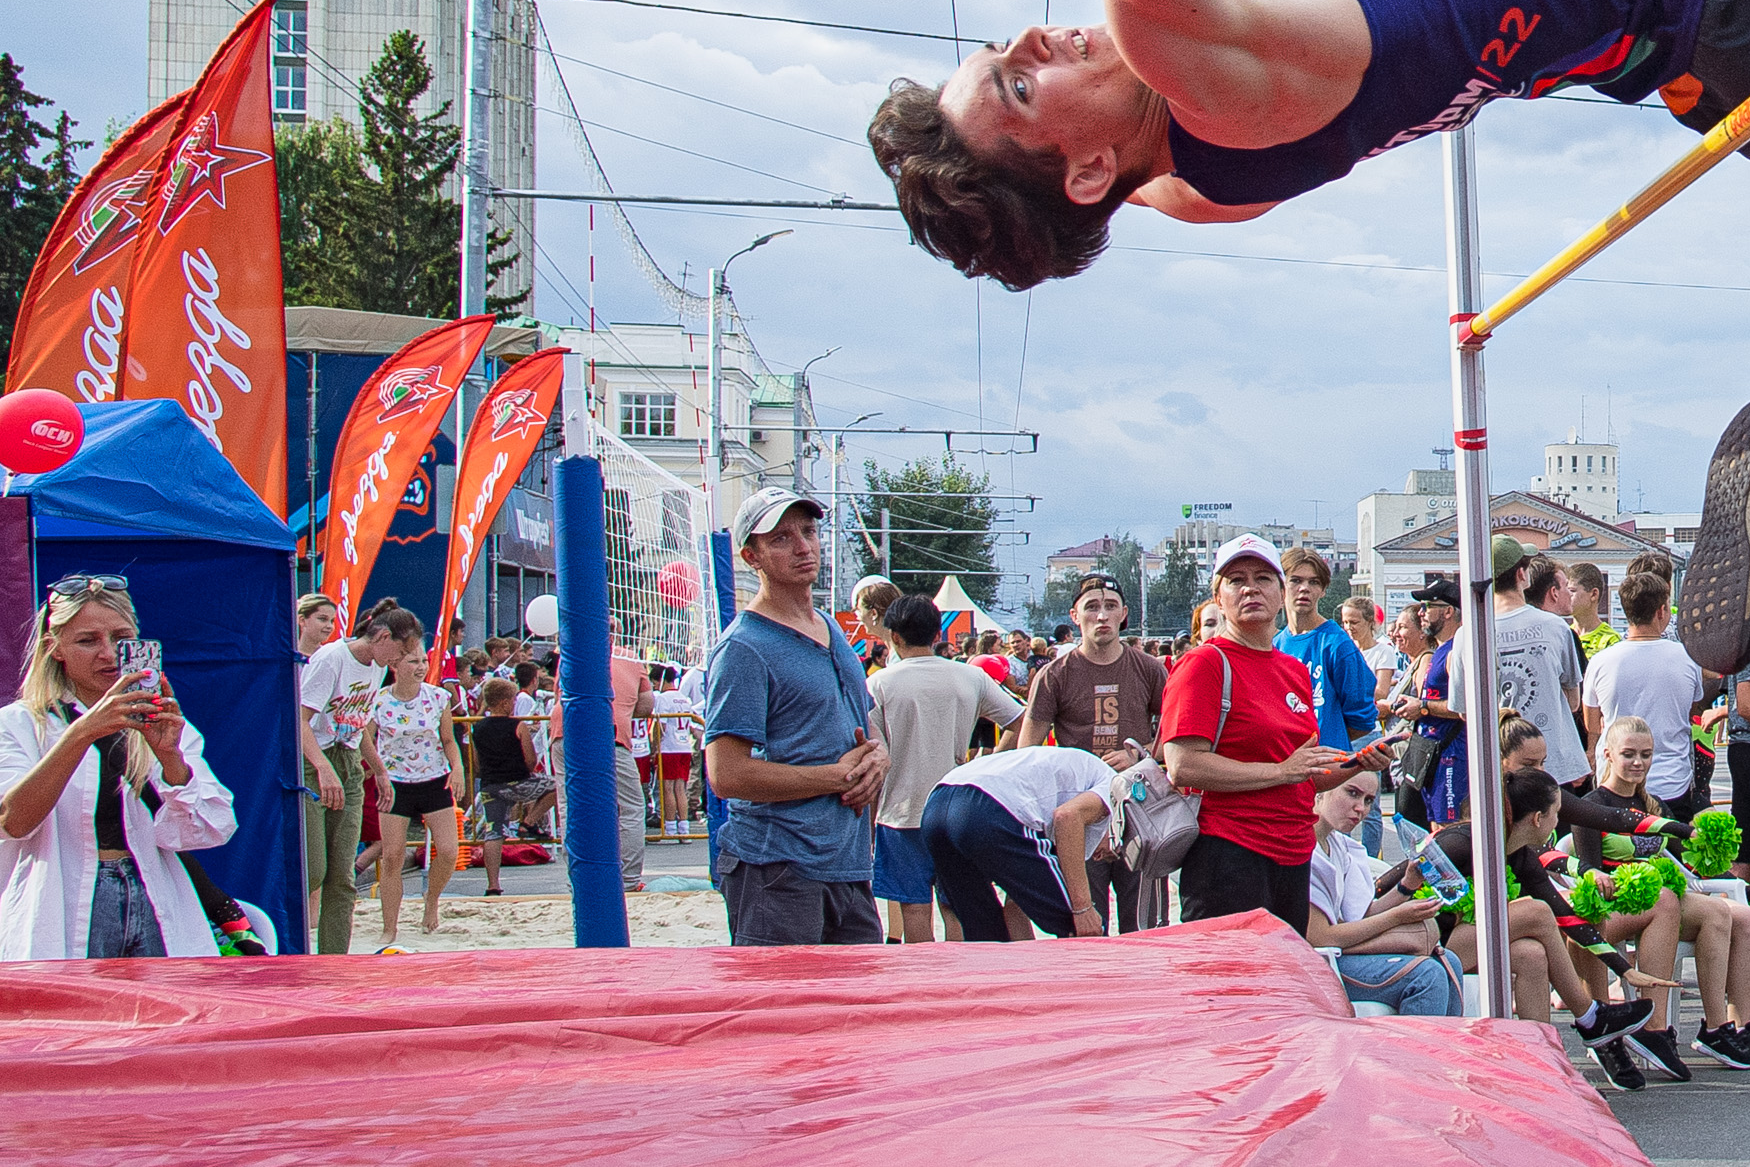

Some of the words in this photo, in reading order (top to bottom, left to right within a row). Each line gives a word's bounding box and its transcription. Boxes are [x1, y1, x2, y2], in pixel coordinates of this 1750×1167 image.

[1194, 502, 1233, 511] FREEDOM
[1194, 511, 1219, 520] finance
[1094, 696, 1119, 725] IS
[1092, 735, 1118, 747] MADE
